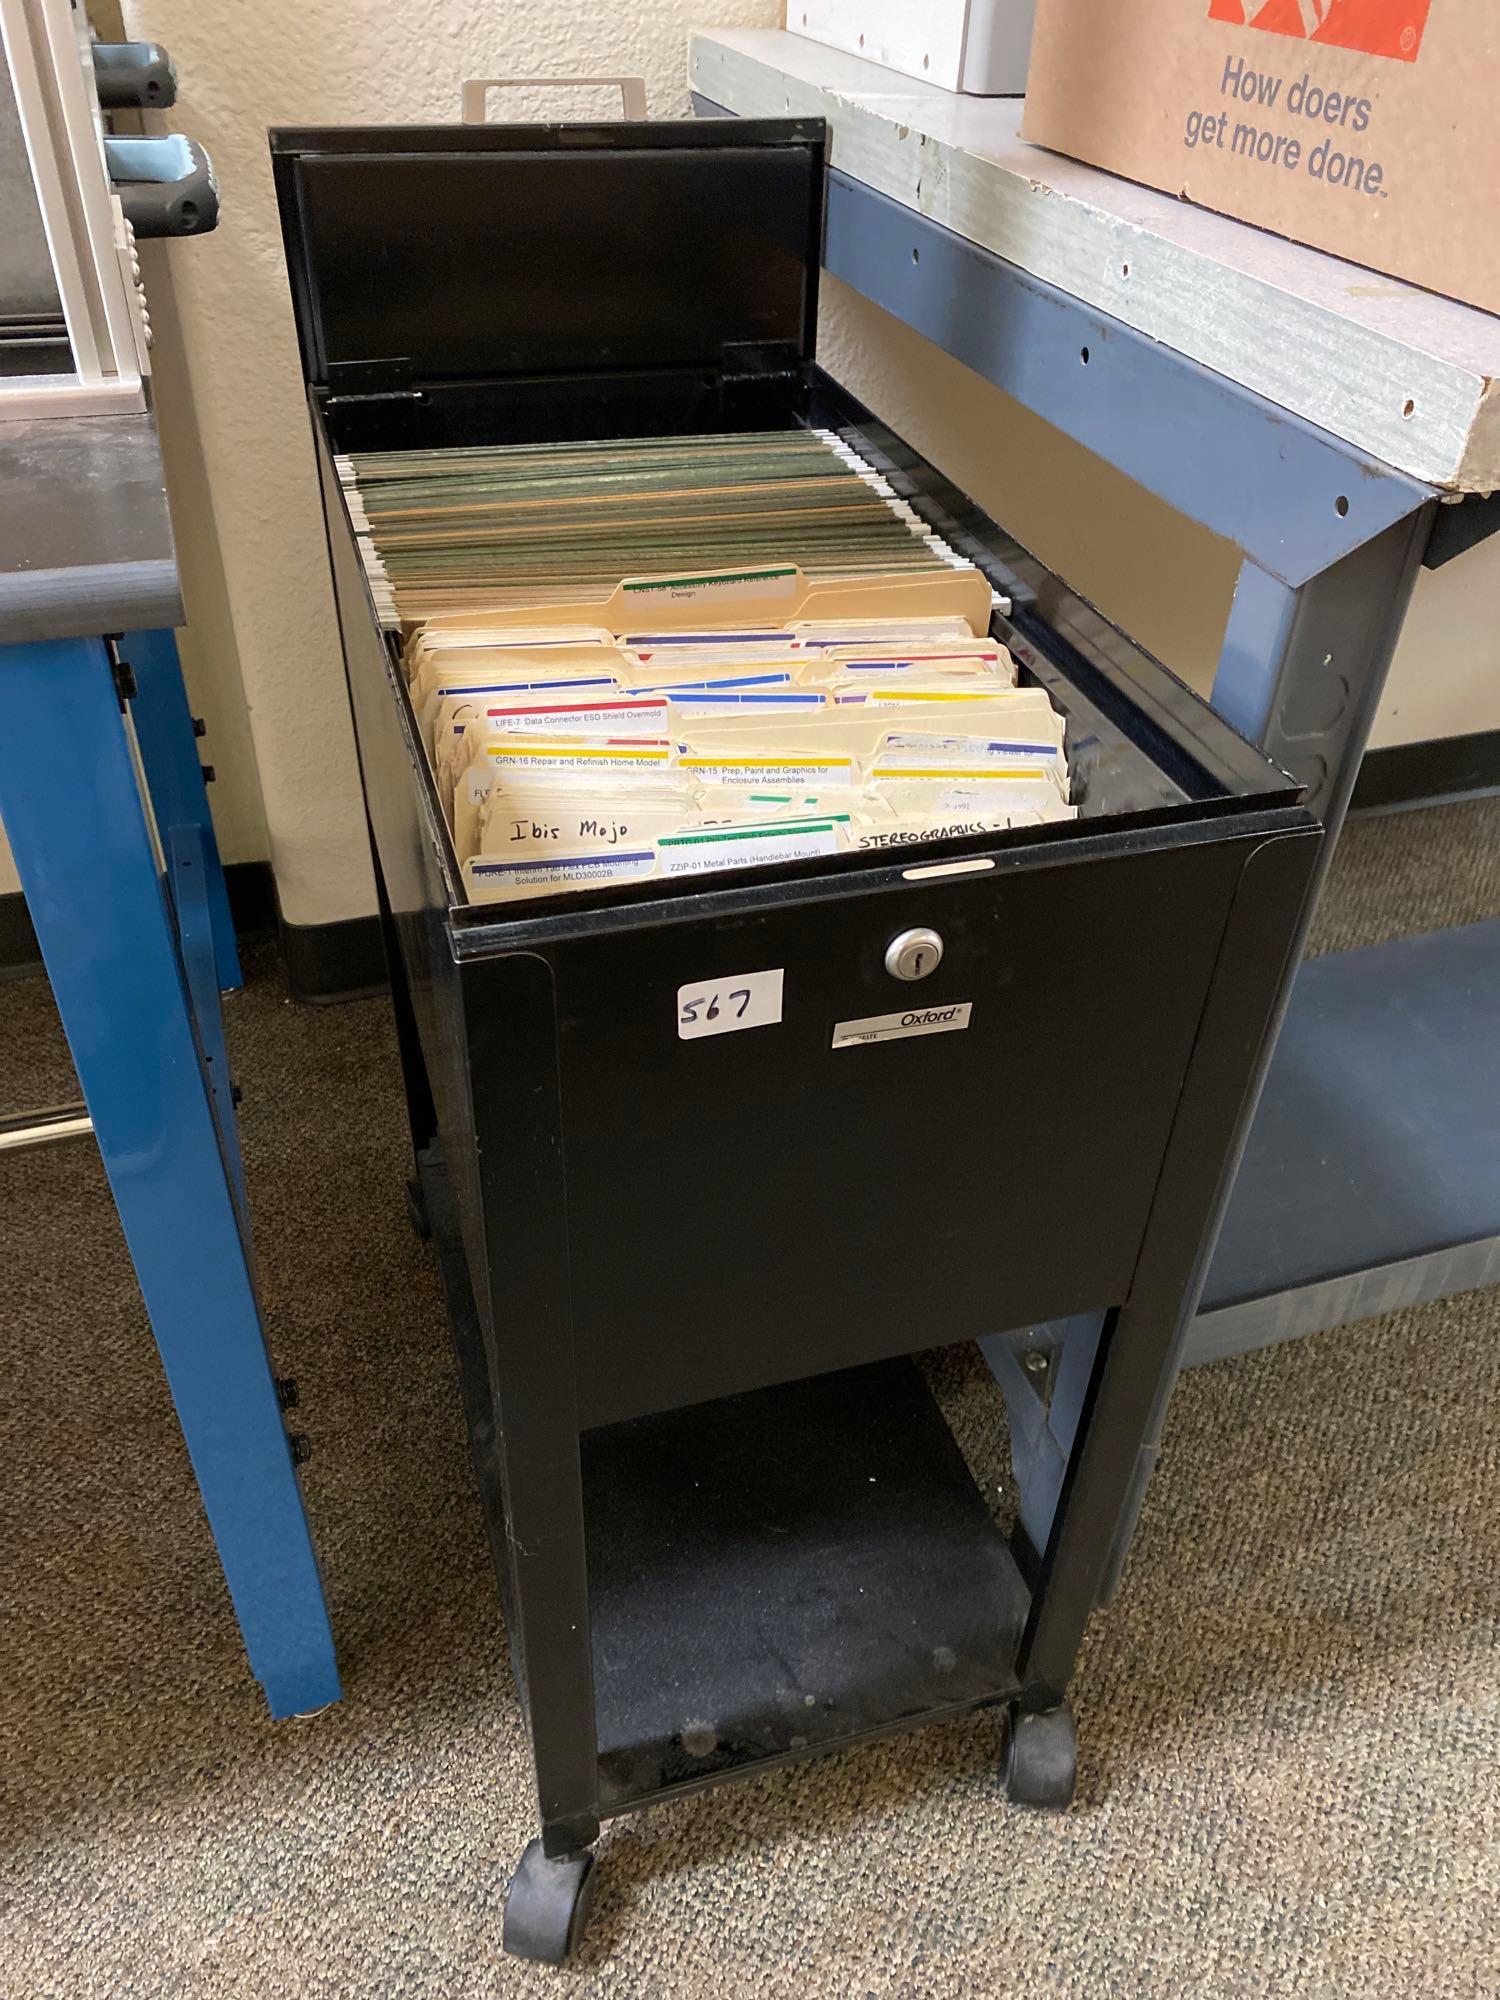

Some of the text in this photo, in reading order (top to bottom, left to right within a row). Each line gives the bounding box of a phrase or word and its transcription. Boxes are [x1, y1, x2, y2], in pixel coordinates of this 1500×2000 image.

[1221, 55, 1371, 131] How doers
[1184, 109, 1228, 149] get
[1231, 122, 1300, 169] more
[671, 591, 697, 599] Design
[496, 718, 520, 727] LIFE-7
[525, 716, 542, 726] Data
[544, 715, 582, 724] Connector
[603, 711, 625, 720] Shield
[627, 710, 661, 719] Overmold
[495, 757, 660, 767] GRN-16 Repair and Refinish Home Model
[744, 766, 764, 774] Paint
[766, 766, 780, 774] and
[782, 766, 816, 776] Graphics
[818, 766, 828, 774] for
[722, 776, 805, 784] Enclosure Assemblies
[510, 820, 628, 844] Ibis Mojo
[704, 858, 726, 868] Metal
[727, 856, 748, 865] Parts
[514, 876, 548, 885] Solution
[550, 874, 561, 882] for
[901, 1007, 957, 1026] Oxford
